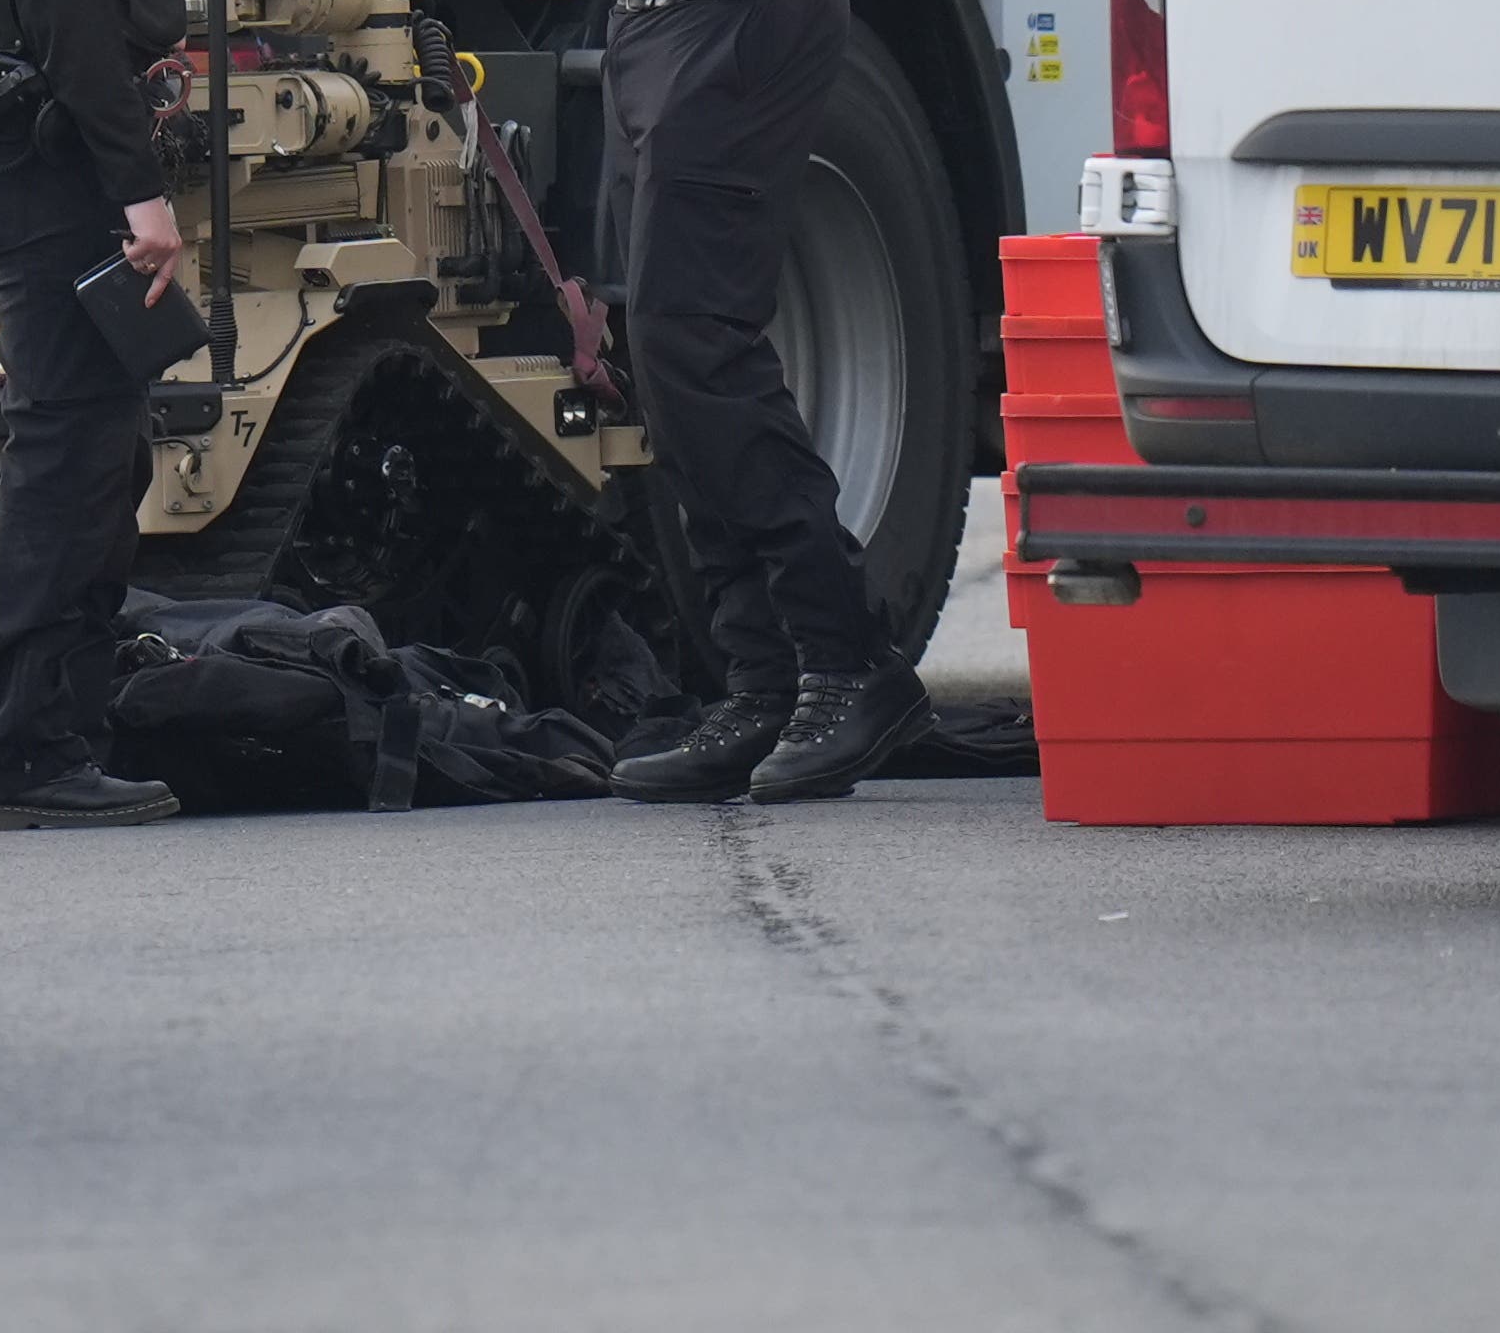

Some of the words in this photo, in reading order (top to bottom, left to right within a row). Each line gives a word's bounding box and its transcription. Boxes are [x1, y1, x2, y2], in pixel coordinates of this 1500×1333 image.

[1352, 196, 1497, 264] WV71
[1297, 241, 1318, 259] UK
[230, 409, 257, 447] T7
